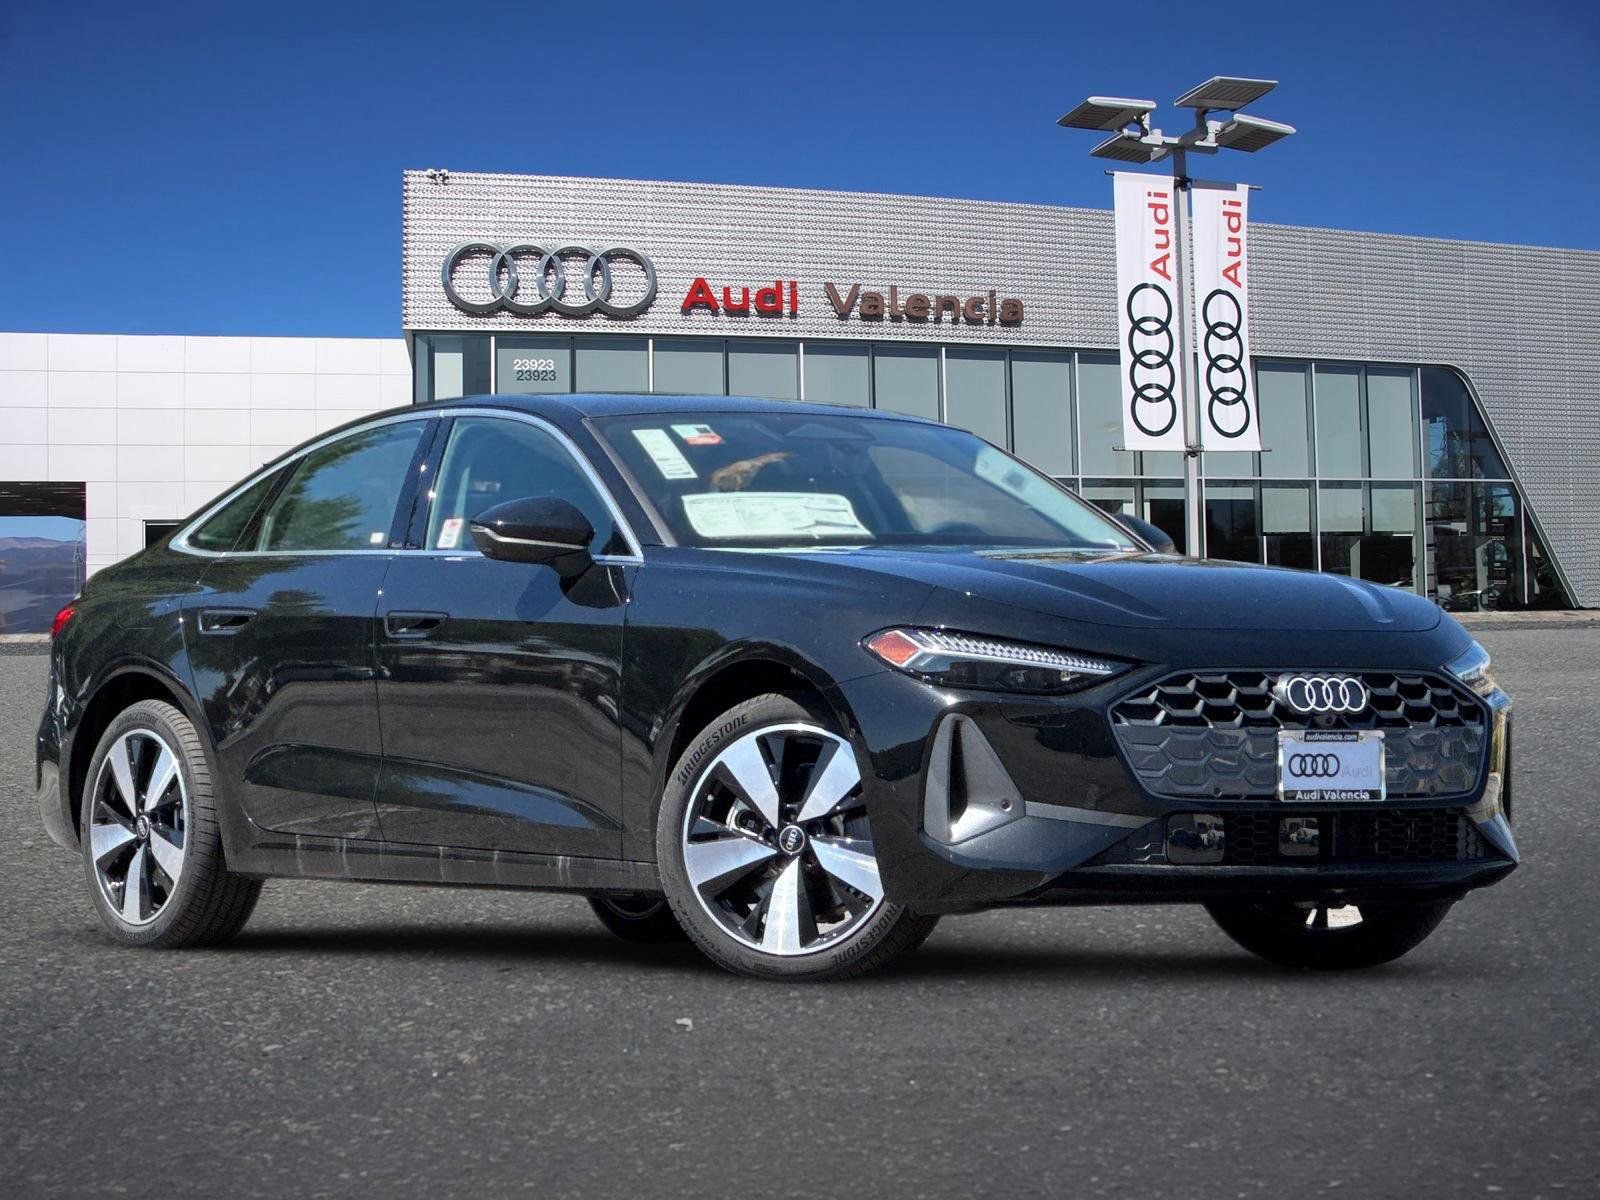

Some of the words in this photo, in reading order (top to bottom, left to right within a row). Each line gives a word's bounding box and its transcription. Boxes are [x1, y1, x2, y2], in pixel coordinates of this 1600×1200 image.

[1147, 191, 1172, 281] Audi
[1222, 199, 1242, 288] Audi
[680, 277, 798, 317] Audi
[824, 282, 1024, 323] Valencia
[513, 358, 555, 370] 23923
[516, 370, 557, 381] 23923
[1341, 764, 1373, 778] Audi
[1295, 790, 1321, 800] Audi
[1322, 790, 1370, 800] Valencia
